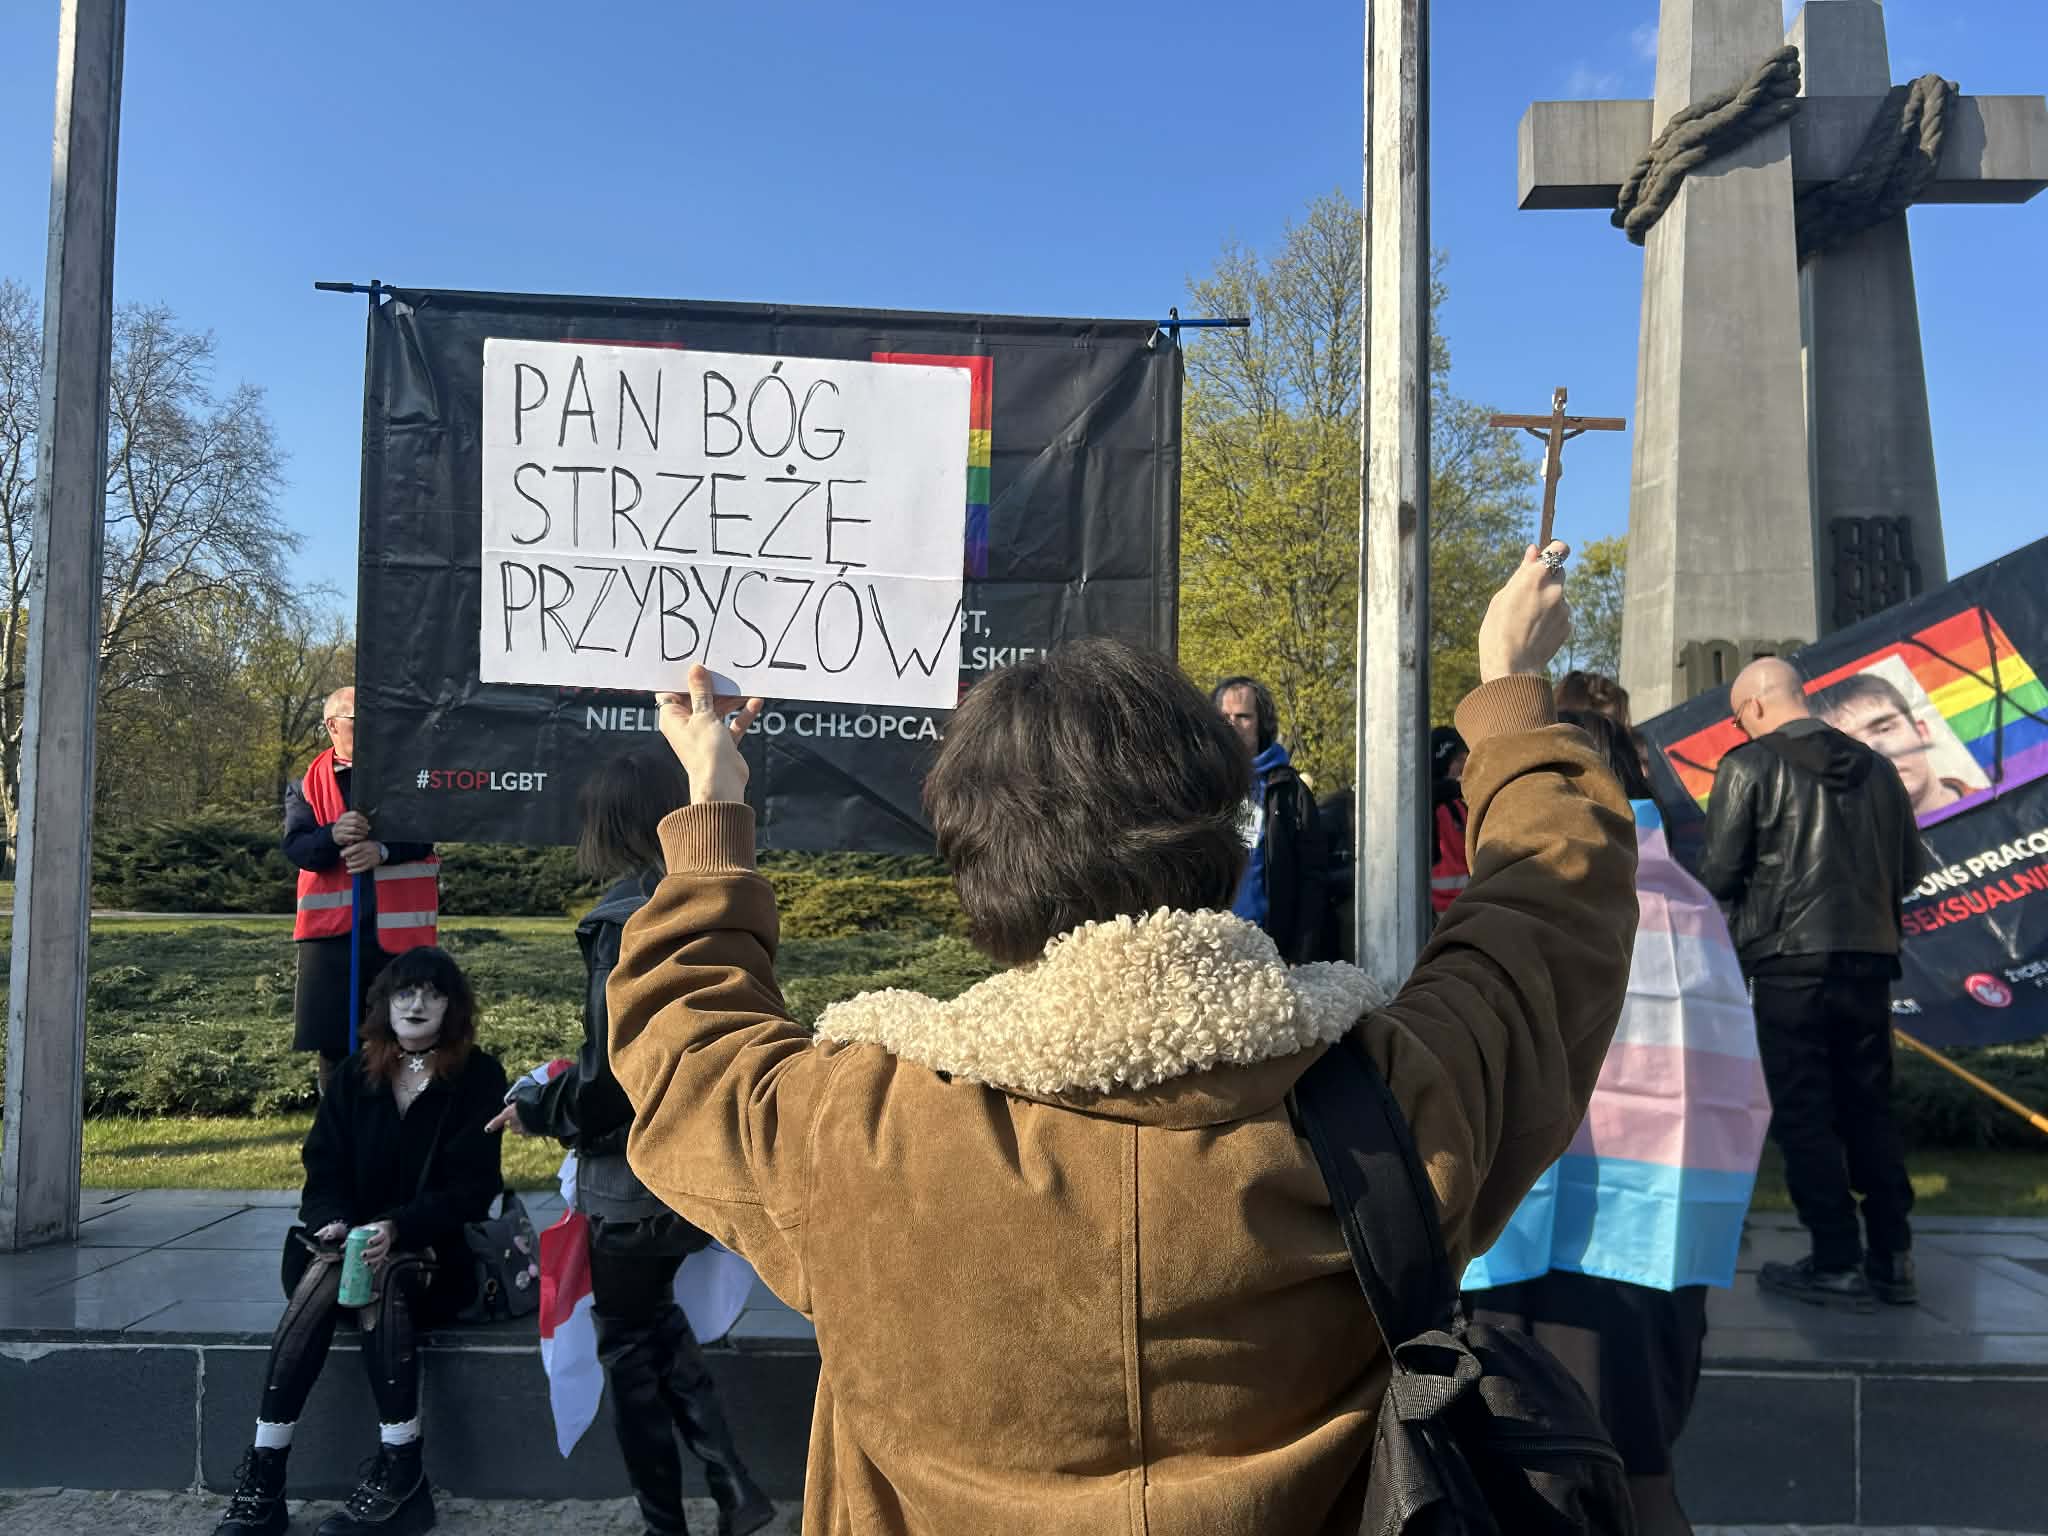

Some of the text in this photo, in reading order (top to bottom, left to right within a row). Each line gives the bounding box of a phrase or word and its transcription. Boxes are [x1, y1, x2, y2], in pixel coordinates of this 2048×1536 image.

[514, 356, 846, 461] PAN BÓG
[511, 462, 872, 568] STRZEŻE
[500, 560, 962, 679] PRZYBYSZÓW
[794, 711, 945, 741] CHŁOPCA.
[416, 769, 548, 792] #STOPLGBT
[1965, 827, 2048, 878] PRACO
[1901, 863, 2048, 936] SEKSUALNI
